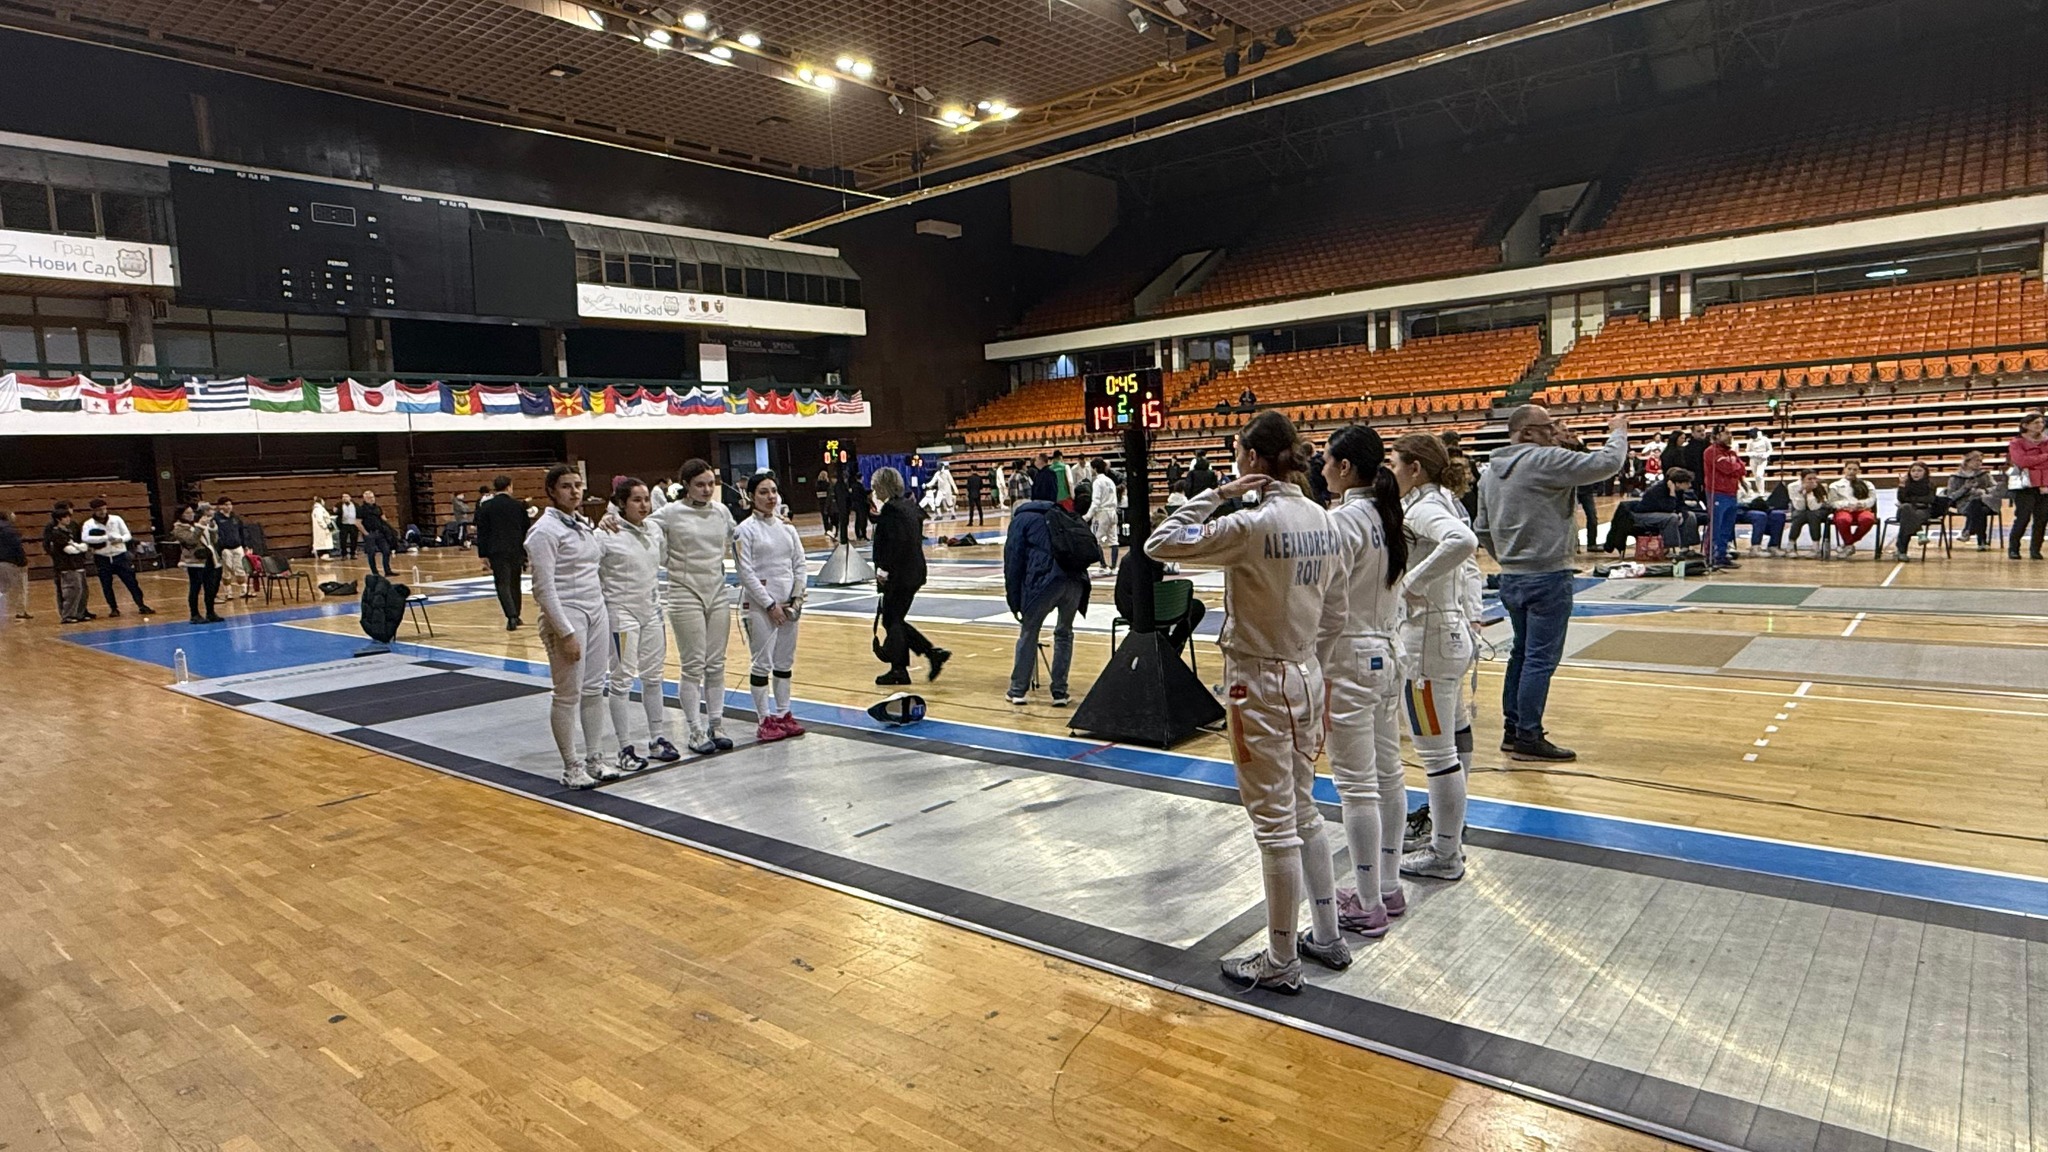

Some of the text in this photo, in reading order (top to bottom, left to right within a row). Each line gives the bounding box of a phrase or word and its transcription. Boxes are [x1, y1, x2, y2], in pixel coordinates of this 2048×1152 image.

[189, 164, 214, 174] PLAYER
[401, 194, 422, 202] PLAYER
[53, 239, 96, 259] Град
[28, 254, 117, 278] Нови Сад
[619, 303, 663, 316] Novi Sad
[732, 339, 762, 348] CENTAR
[771, 341, 796, 350] SPENS
[1105, 373, 1139, 395] 0:45
[1094, 405, 1113, 430] 14
[1142, 400, 1162, 428] 15
[1264, 530, 1340, 560] ALEXANDRECU
[1295, 560, 1322, 586] ROU
